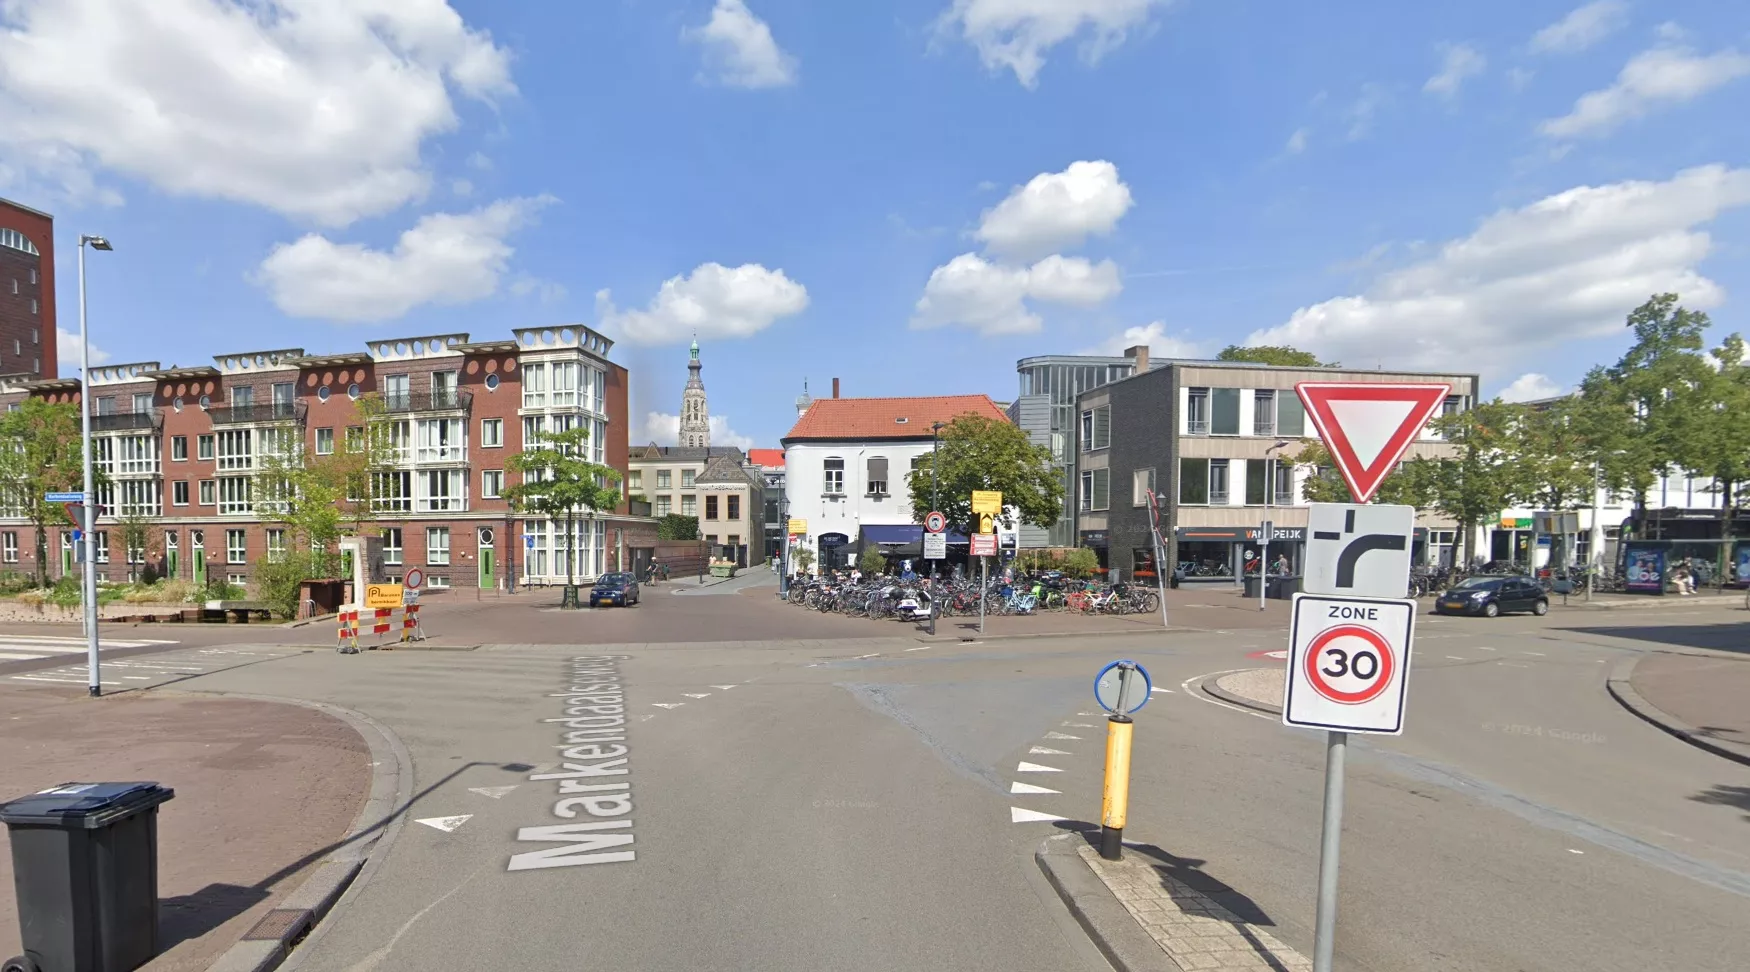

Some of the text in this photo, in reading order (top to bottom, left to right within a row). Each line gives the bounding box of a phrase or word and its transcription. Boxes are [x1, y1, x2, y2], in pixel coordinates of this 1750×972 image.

[1274, 529, 1301, 539] PEIJK
[1329, 606, 1378, 620] ZONE
[1322, 649, 1378, 680] 30
